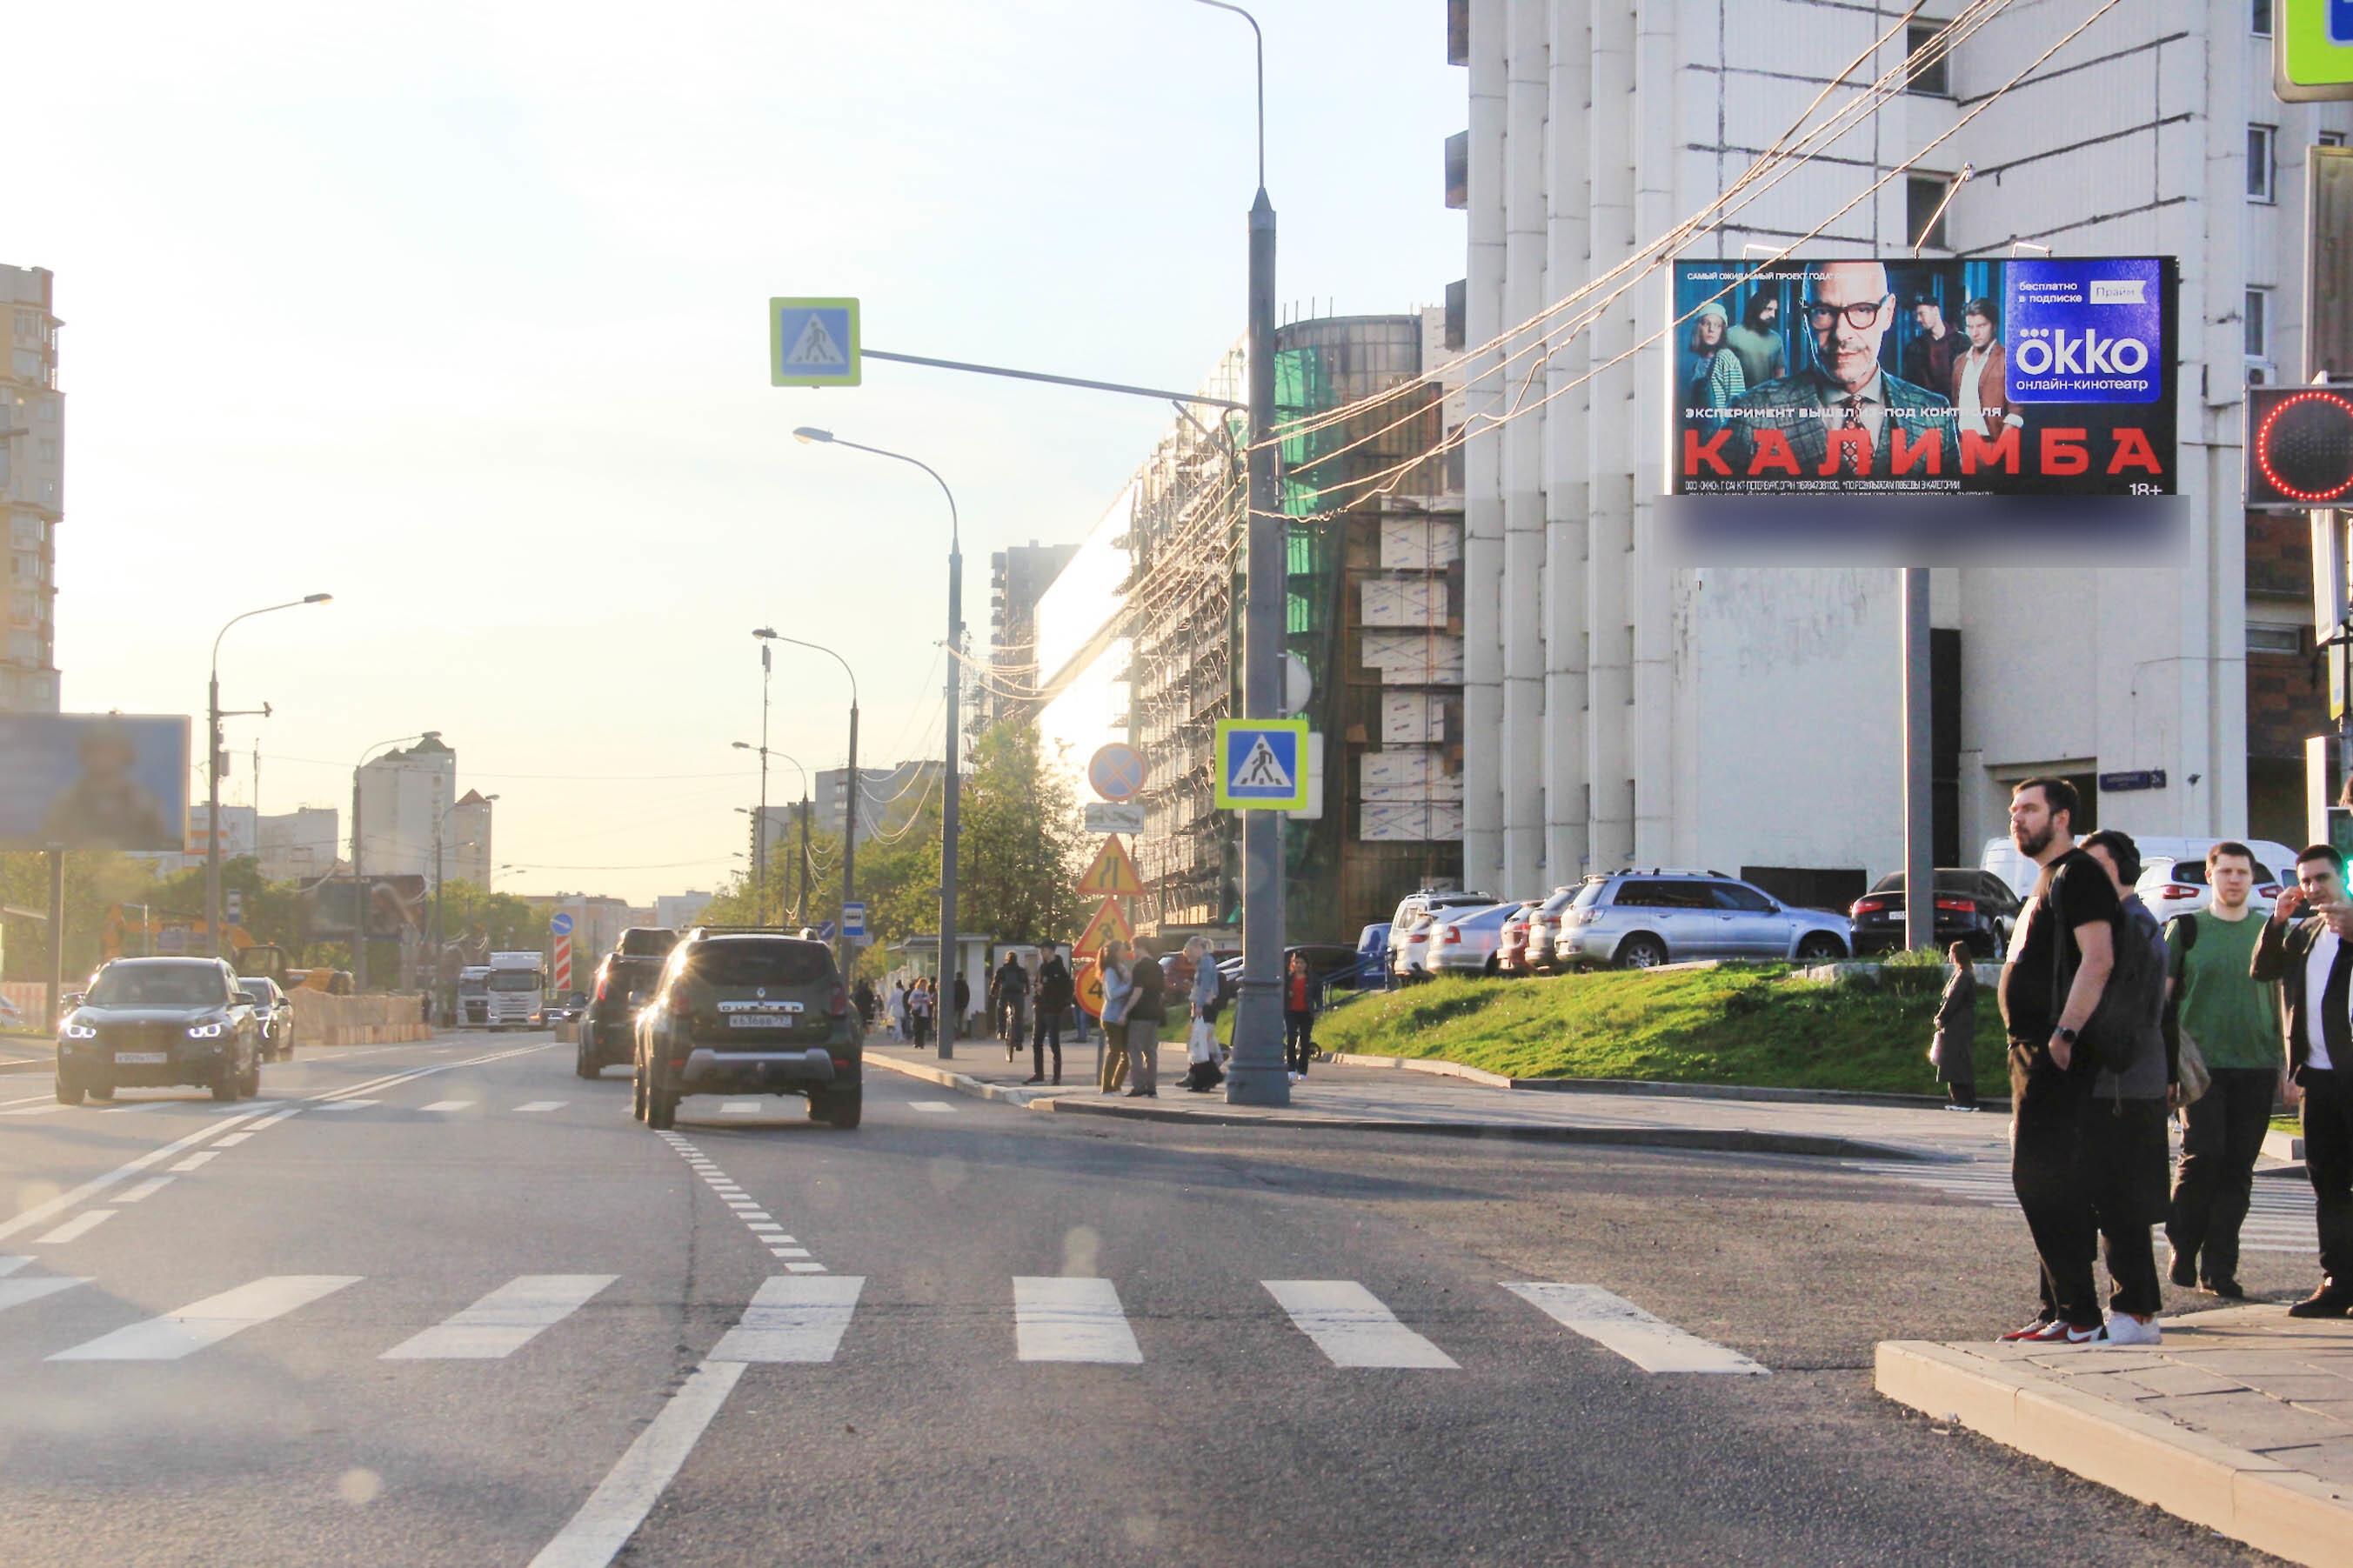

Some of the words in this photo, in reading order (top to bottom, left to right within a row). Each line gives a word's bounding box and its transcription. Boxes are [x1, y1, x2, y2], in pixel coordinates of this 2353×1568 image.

[1687, 271, 1717, 280] САМЫЙ
[2019, 281, 2077, 291] бесплатно
[2029, 294, 2082, 304] подписке
[2016, 378, 2149, 391] онлайн-кинотеатр
[1685, 408, 1795, 418] ЭКСПЕРИМЕНТ
[1920, 407, 2002, 417] КОНТЛЯ
[1684, 427, 2163, 476] КАЛИМБА
[2129, 483, 2163, 496] 18+
